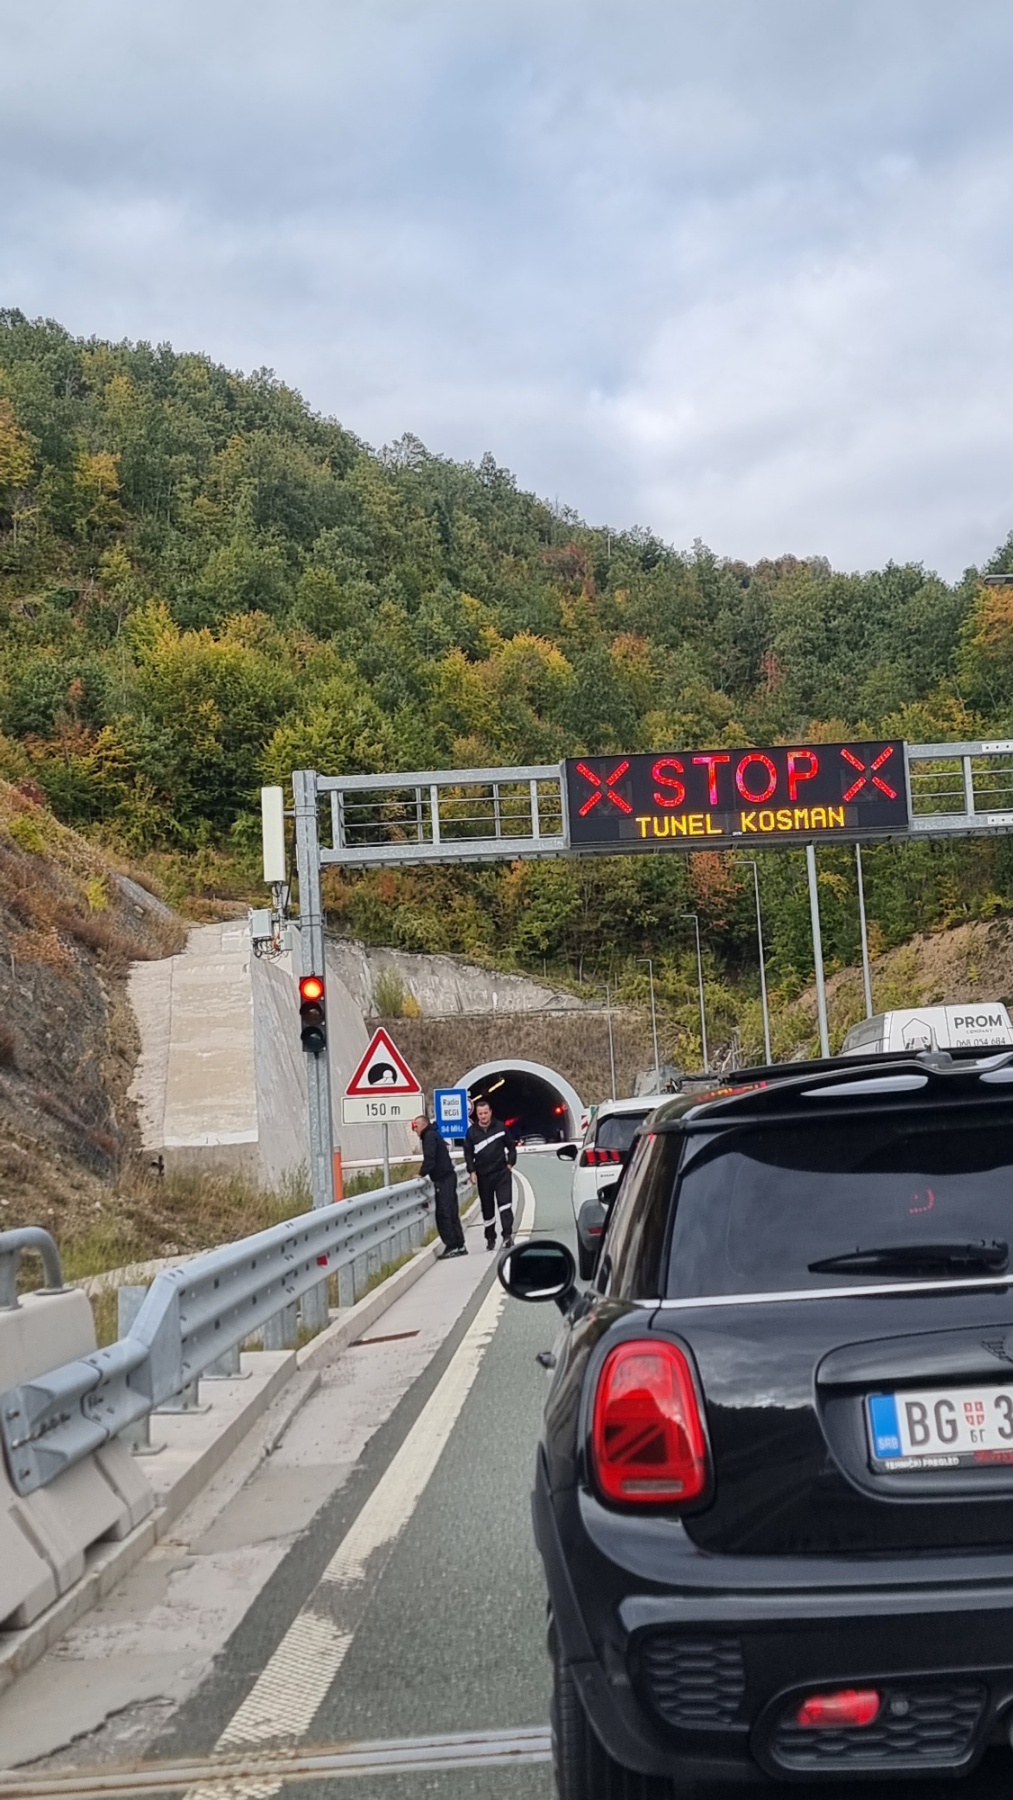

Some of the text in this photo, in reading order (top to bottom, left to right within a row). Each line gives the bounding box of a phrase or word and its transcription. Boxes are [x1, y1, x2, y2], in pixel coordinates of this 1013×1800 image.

[651, 750, 819, 808] STOP
[635, 806, 845, 838] TUNEL KOSMAN
[954, 1014, 1003, 1029] PROM
[442, 1098, 460, 1106] Radio
[366, 1103, 401, 1116] 150 m
[450, 1124, 464, 1133] MHz
[905, 1399, 959, 1447] BG
[877, 1437, 899, 1450] SRB
[923, 1457, 960, 1467] PREGLED
